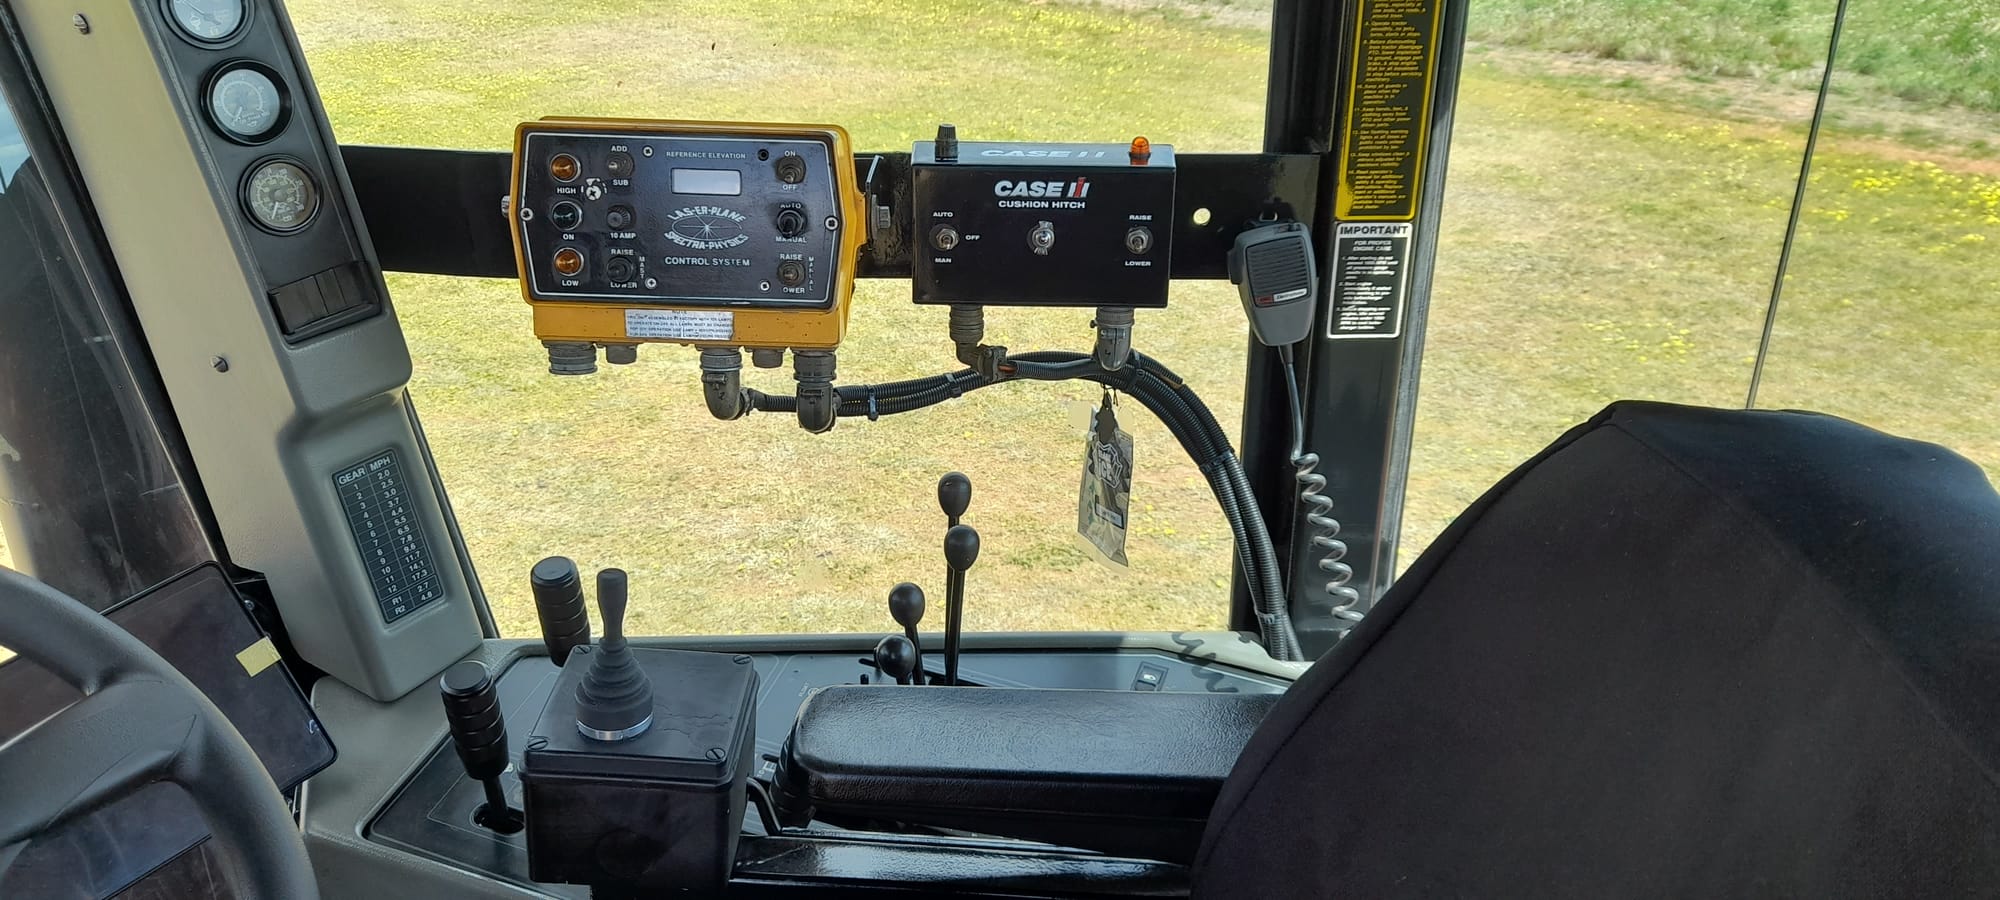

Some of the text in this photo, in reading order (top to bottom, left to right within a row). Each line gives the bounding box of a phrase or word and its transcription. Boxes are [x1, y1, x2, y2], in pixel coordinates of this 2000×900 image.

[994, 180, 1064, 197] CASE
[998, 200, 1048, 208] CUSHION
[667, 206, 746, 222] LAS-ER-PLANE
[1340, 226, 1408, 234] IMPORTANT
[664, 231, 749, 250] SPECTRA-PHYSICS
[610, 248, 634, 256] RAISE
[664, 256, 750, 266] CONTROL SYSTEM
[338, 456, 390, 484] GEAR MPH
[378, 469, 390, 480] 2.0
[381, 479, 394, 489] 2.5
[384, 488, 396, 498] 3.0
[388, 497, 400, 508] 3.7
[391, 507, 403, 517] 4.4
[394, 516, 406, 527] 5.5
[397, 525, 410, 535] 6.5
[400, 534, 413, 544] 7.8
[404, 542, 416, 553] 9.6
[382, 550, 420, 575] 10 11.7
[386, 560, 424, 583] 11 14.1
[388, 569, 428, 593] 12 17.3
[392, 582, 429, 605] R1 2.7
[395, 605, 406, 615] R2
